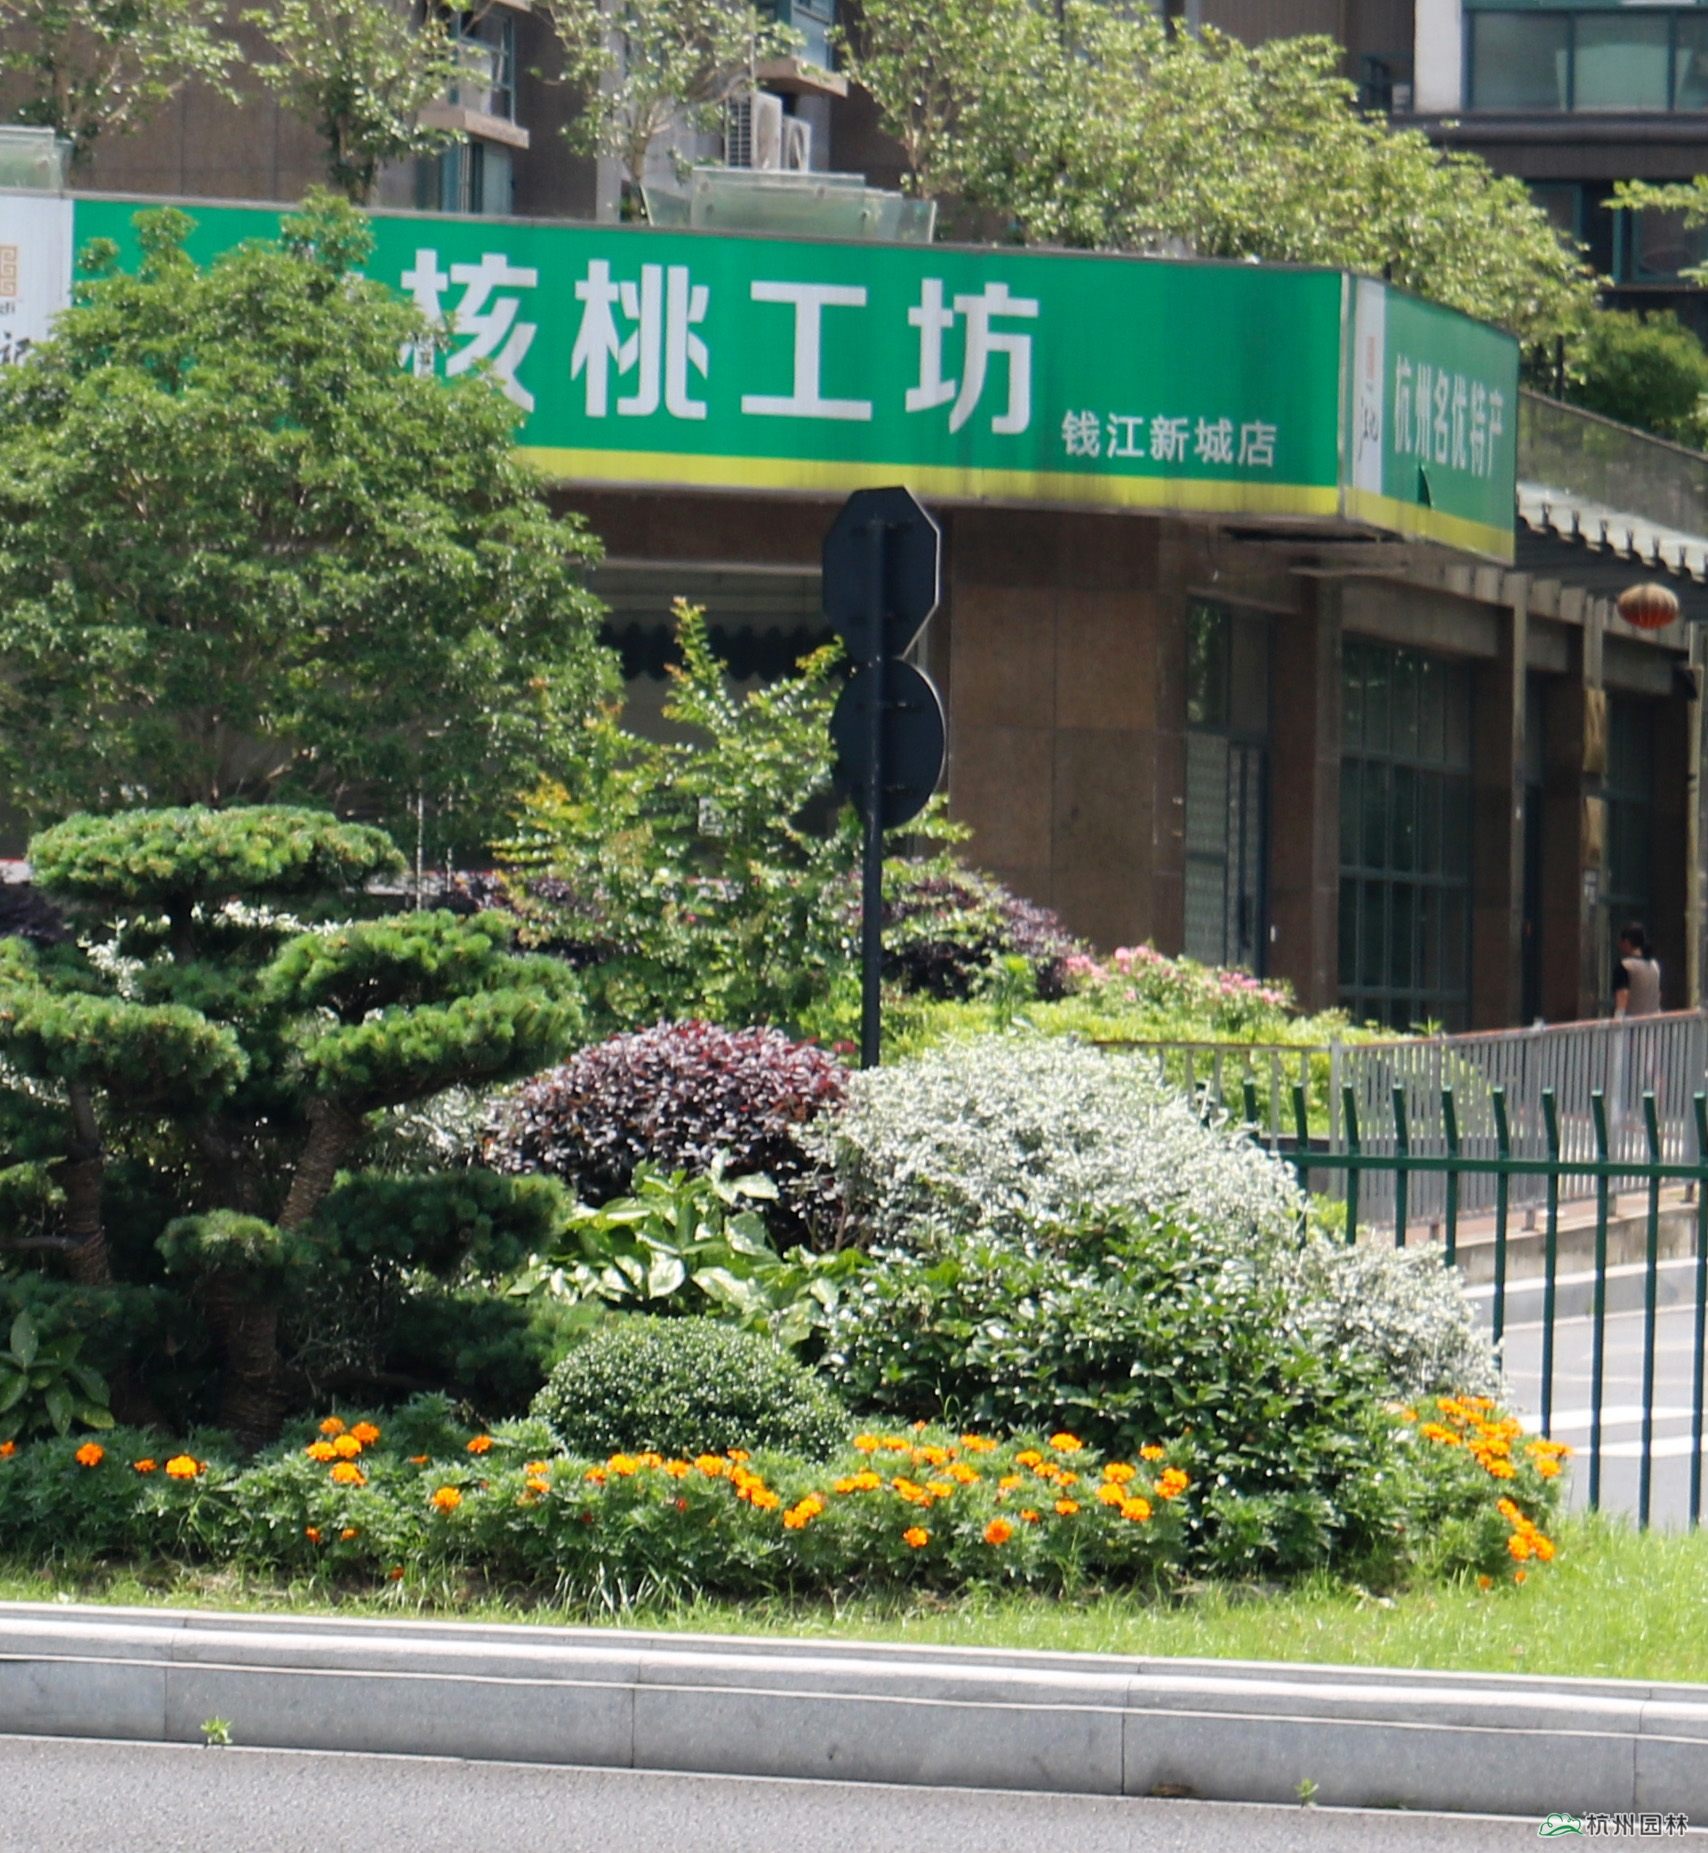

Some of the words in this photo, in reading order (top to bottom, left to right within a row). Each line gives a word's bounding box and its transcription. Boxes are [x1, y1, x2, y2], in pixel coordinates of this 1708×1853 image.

[341, 248, 1039, 436] 核桃工坊
[1060, 409, 1277, 467] 钱江新城店
[1394, 353, 1504, 479] 杭州名优特产
